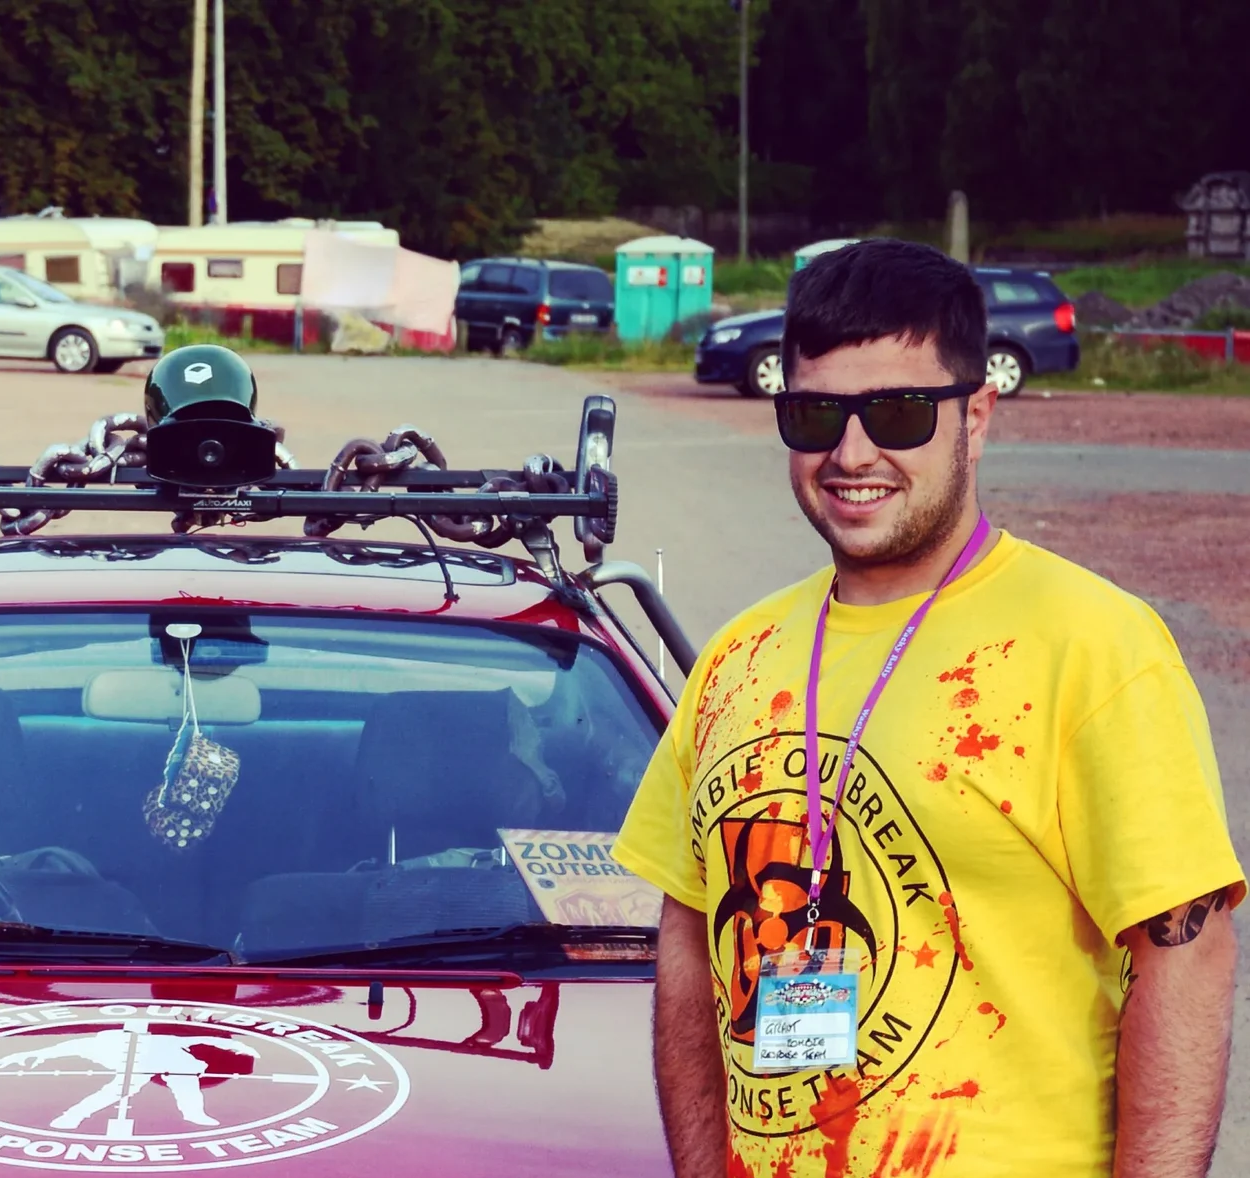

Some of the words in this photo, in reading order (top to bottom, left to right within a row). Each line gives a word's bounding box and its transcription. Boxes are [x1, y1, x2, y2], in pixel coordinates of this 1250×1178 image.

[894, 626, 916, 653] Wacky
[881, 654, 899, 679] Rally
[851, 708, 870, 738] Wacky
[691, 752, 762, 887] OMBIE
[783, 747, 935, 908] OUBREAK
[99, 1003, 376, 1067] OUTBREAK
[195, 1116, 339, 1160] TEAM
